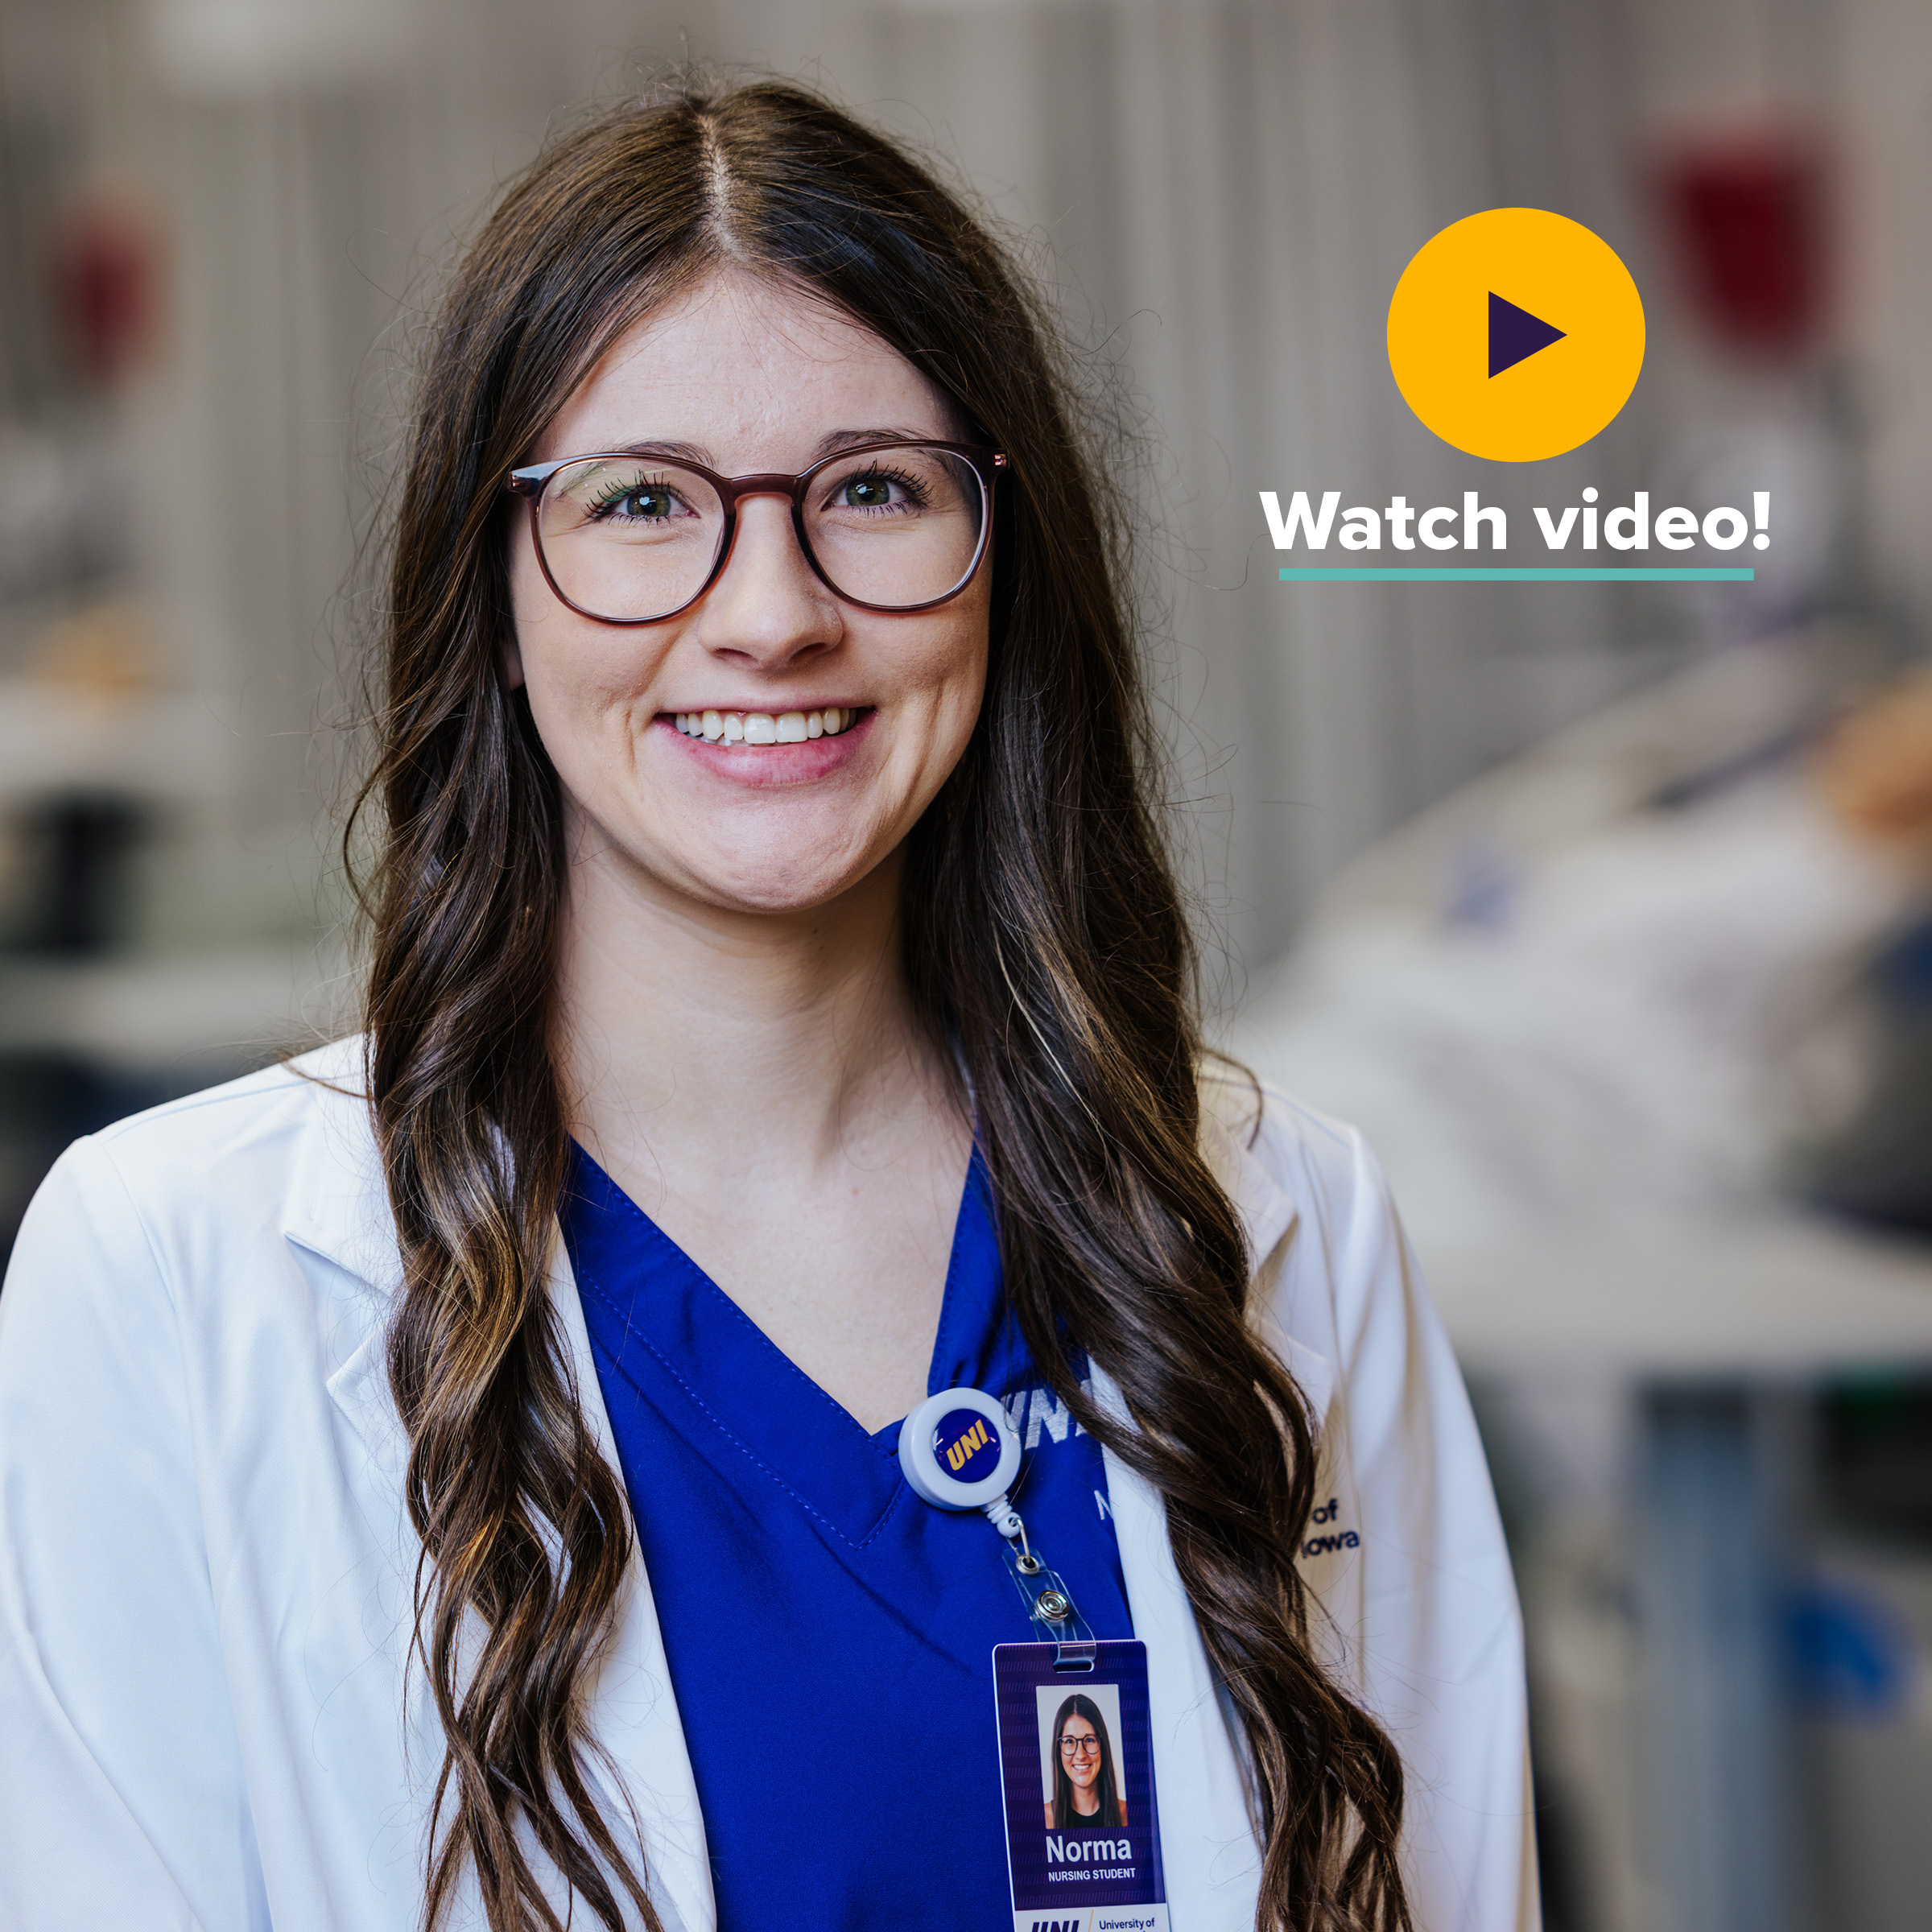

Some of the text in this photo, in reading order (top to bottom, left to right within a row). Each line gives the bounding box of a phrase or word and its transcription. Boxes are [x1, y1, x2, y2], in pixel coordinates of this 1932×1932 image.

[946, 1418, 989, 1471] UNI
[1312, 1498, 1338, 1524] of
[1046, 1835, 1132, 1863] Norma
[1048, 1868, 1136, 1882] NURSING STUDENT
[1099, 1917, 1155, 1930] University of
